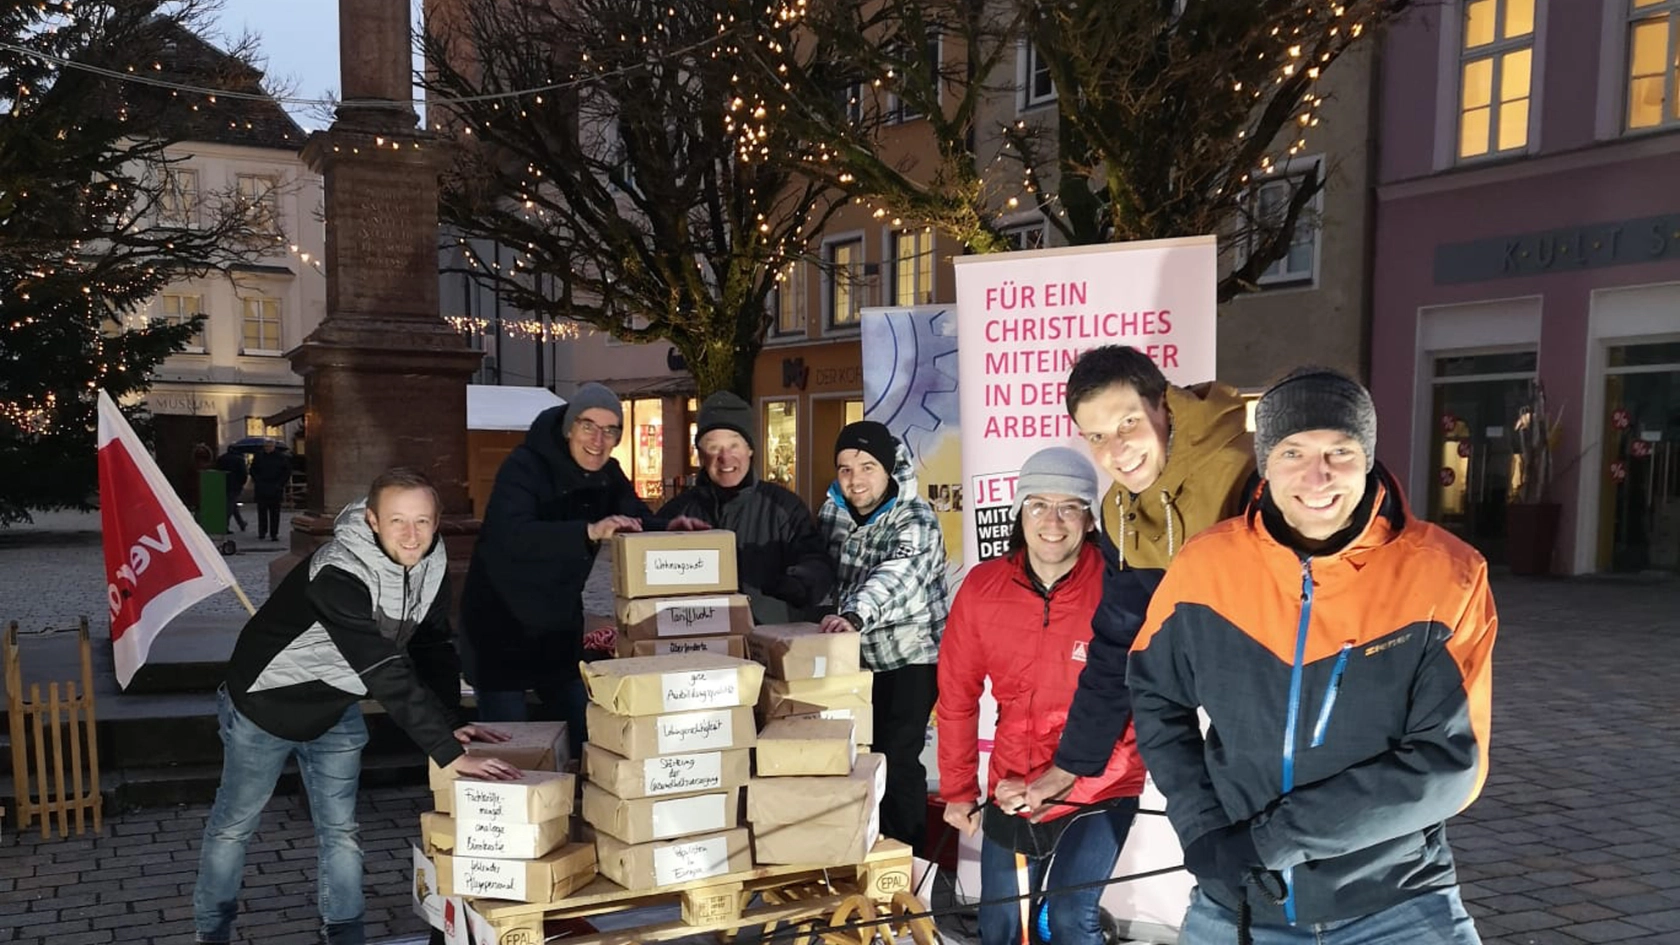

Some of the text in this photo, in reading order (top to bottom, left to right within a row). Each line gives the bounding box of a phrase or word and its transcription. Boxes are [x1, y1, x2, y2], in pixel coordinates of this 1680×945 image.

[985, 281, 1088, 311] FÜR EIN
[984, 309, 1173, 343] CHRISTLICHES
[985, 384, 1012, 407] IN
[984, 415, 1085, 438] ARBEIT
[881, 875, 905, 890] EPAL
